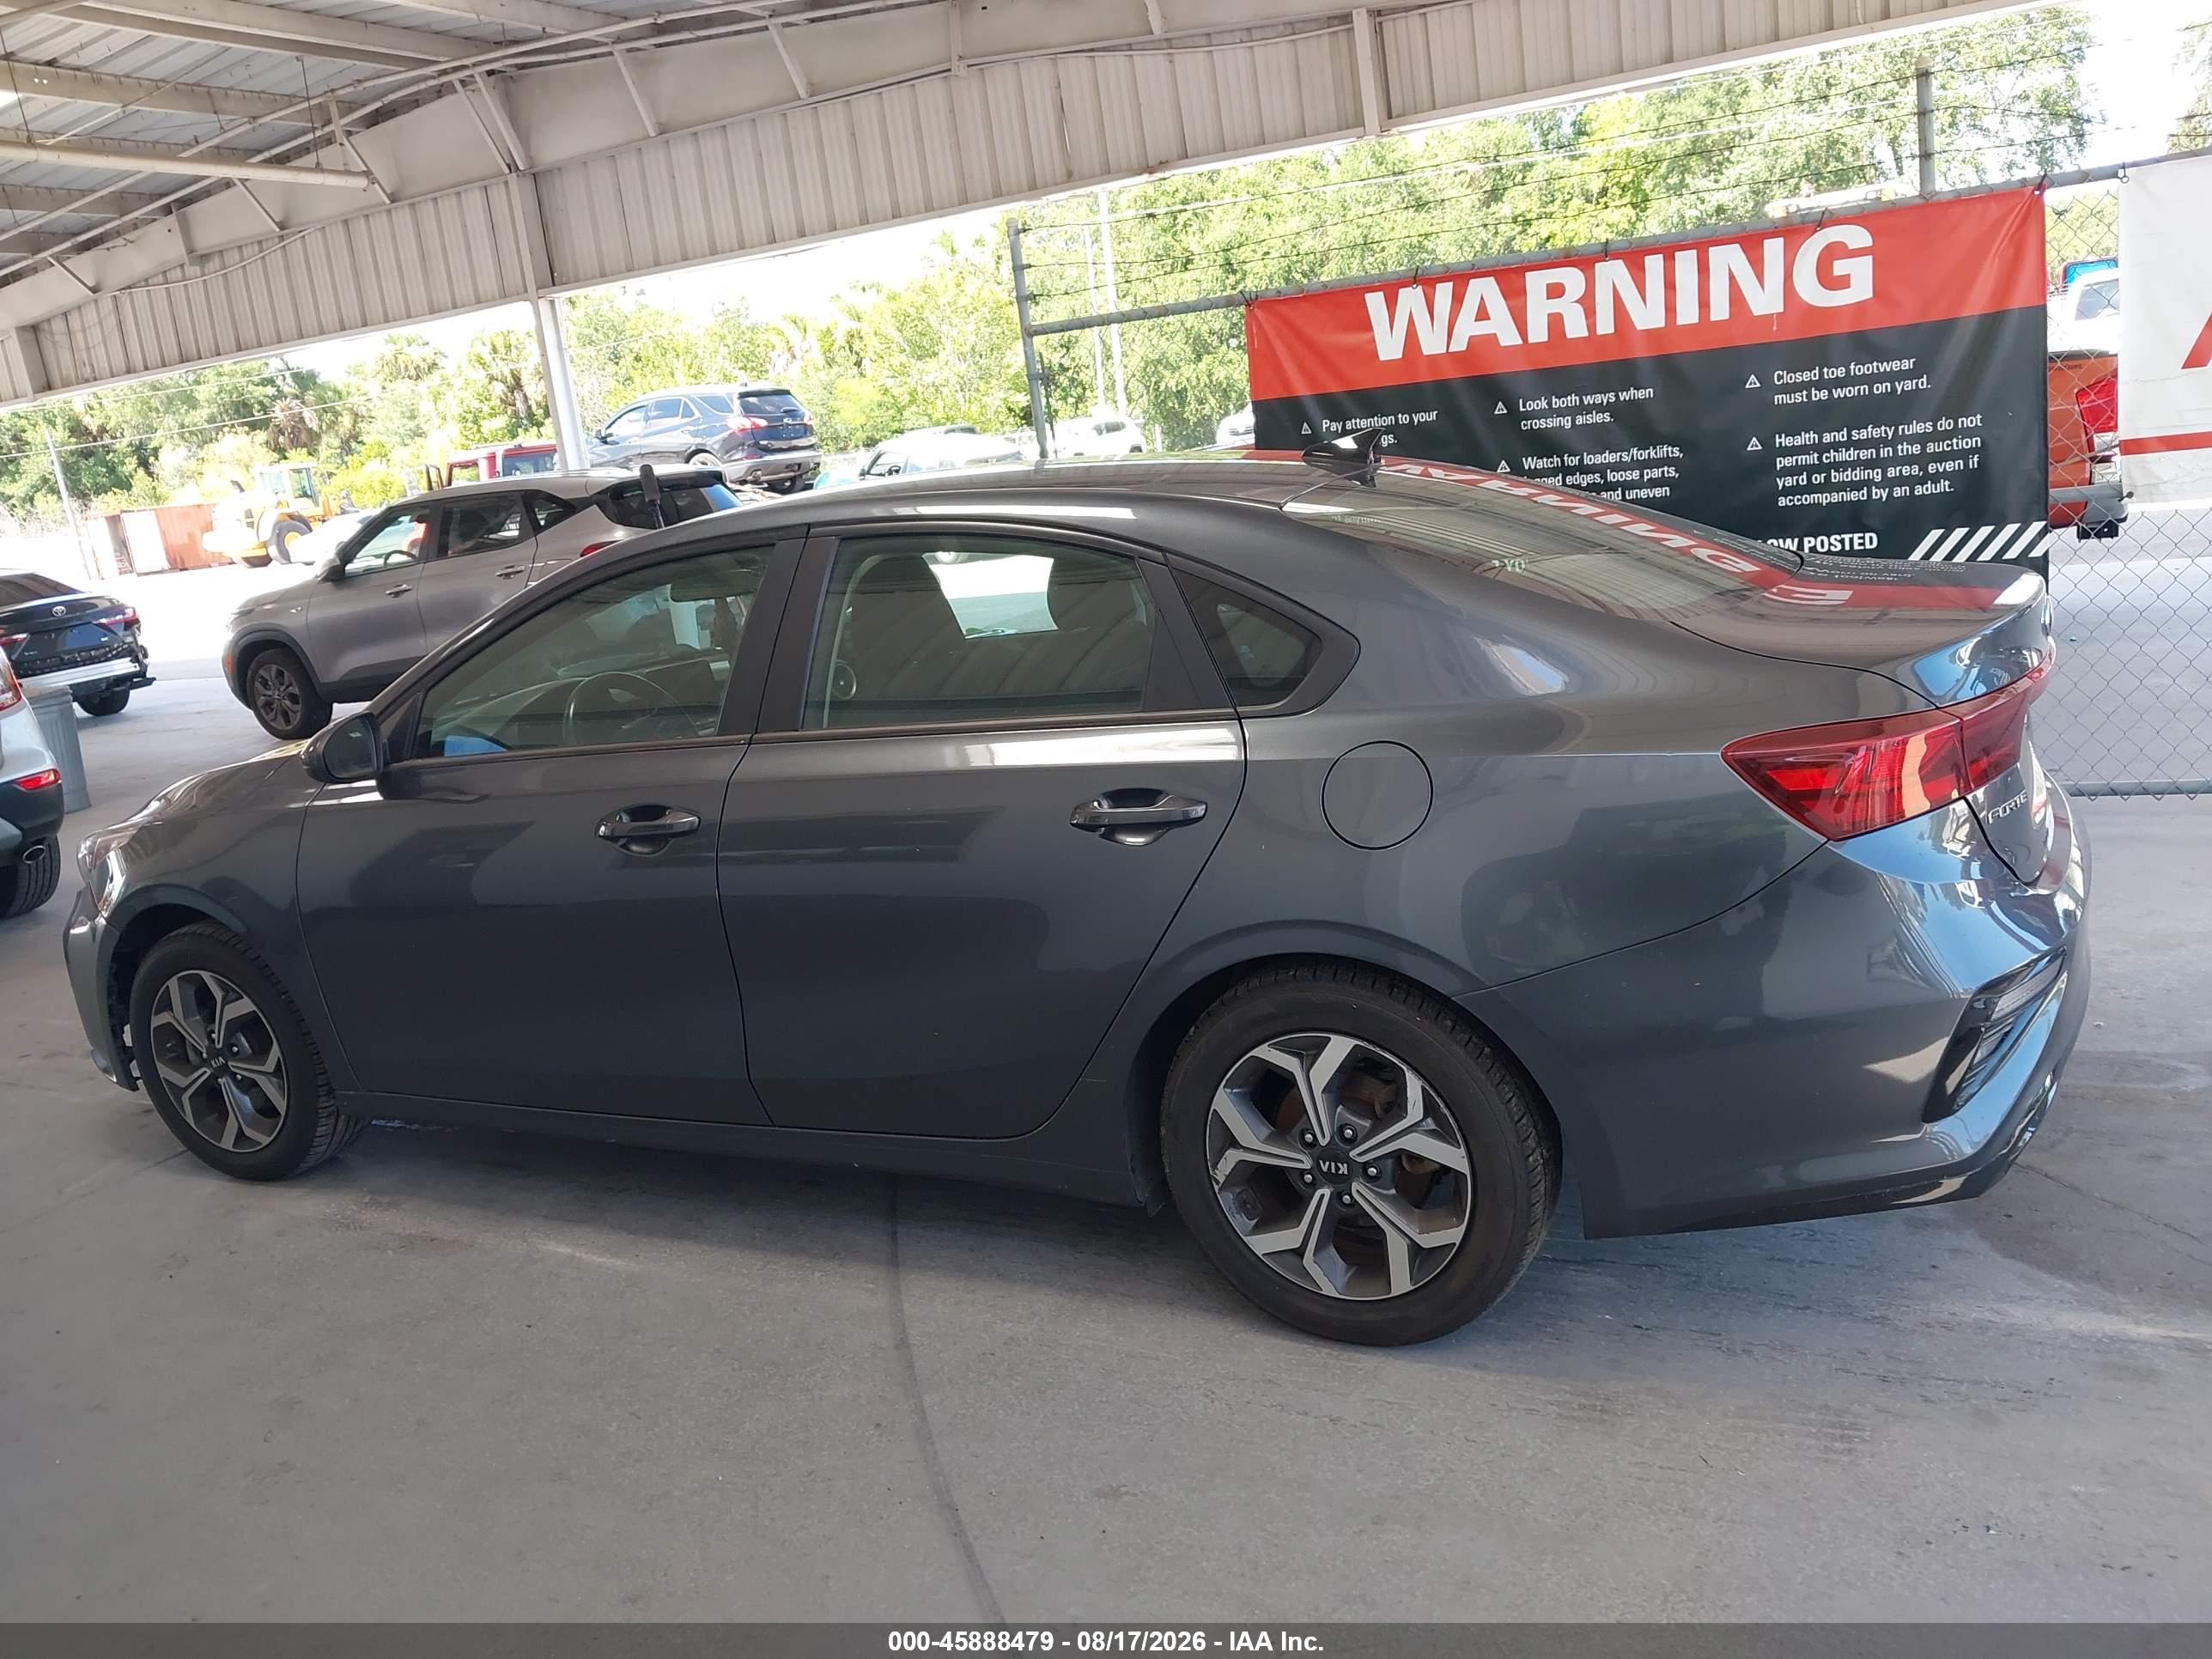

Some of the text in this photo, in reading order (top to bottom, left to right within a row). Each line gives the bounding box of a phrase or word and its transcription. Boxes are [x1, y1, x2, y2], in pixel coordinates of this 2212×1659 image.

[1364, 224, 1875, 361] WARNING
[1773, 357, 1917, 385] Closed toe footwear
[1519, 386, 1654, 411] Look both ways when
[1774, 374, 1931, 405] must be worn on yard.
[1322, 410, 1438, 434] Pay attention to your
[1521, 410, 1614, 430] crossing aisles.
[1775, 413, 1983, 447] Health and safety rules do not
[1522, 444, 1684, 471] Watch for loaders/forklifts,
[1776, 436, 1981, 471] permit children in the auction
[1565, 471, 1605, 487] edges,
[1607, 468, 1640, 482] loose
[1644, 465, 1680, 481] parts,
[1776, 453, 1980, 490] yard or bidding area, even if
[1601, 487, 1622, 501] and
[1625, 486, 1670, 500] uneven
[1778, 478, 1954, 507] accompanied by an adult.
[1803, 532, 1879, 554] POSTED
[210, 1056, 226, 1068] KIA
[1319, 1159, 1348, 1176] KIA
